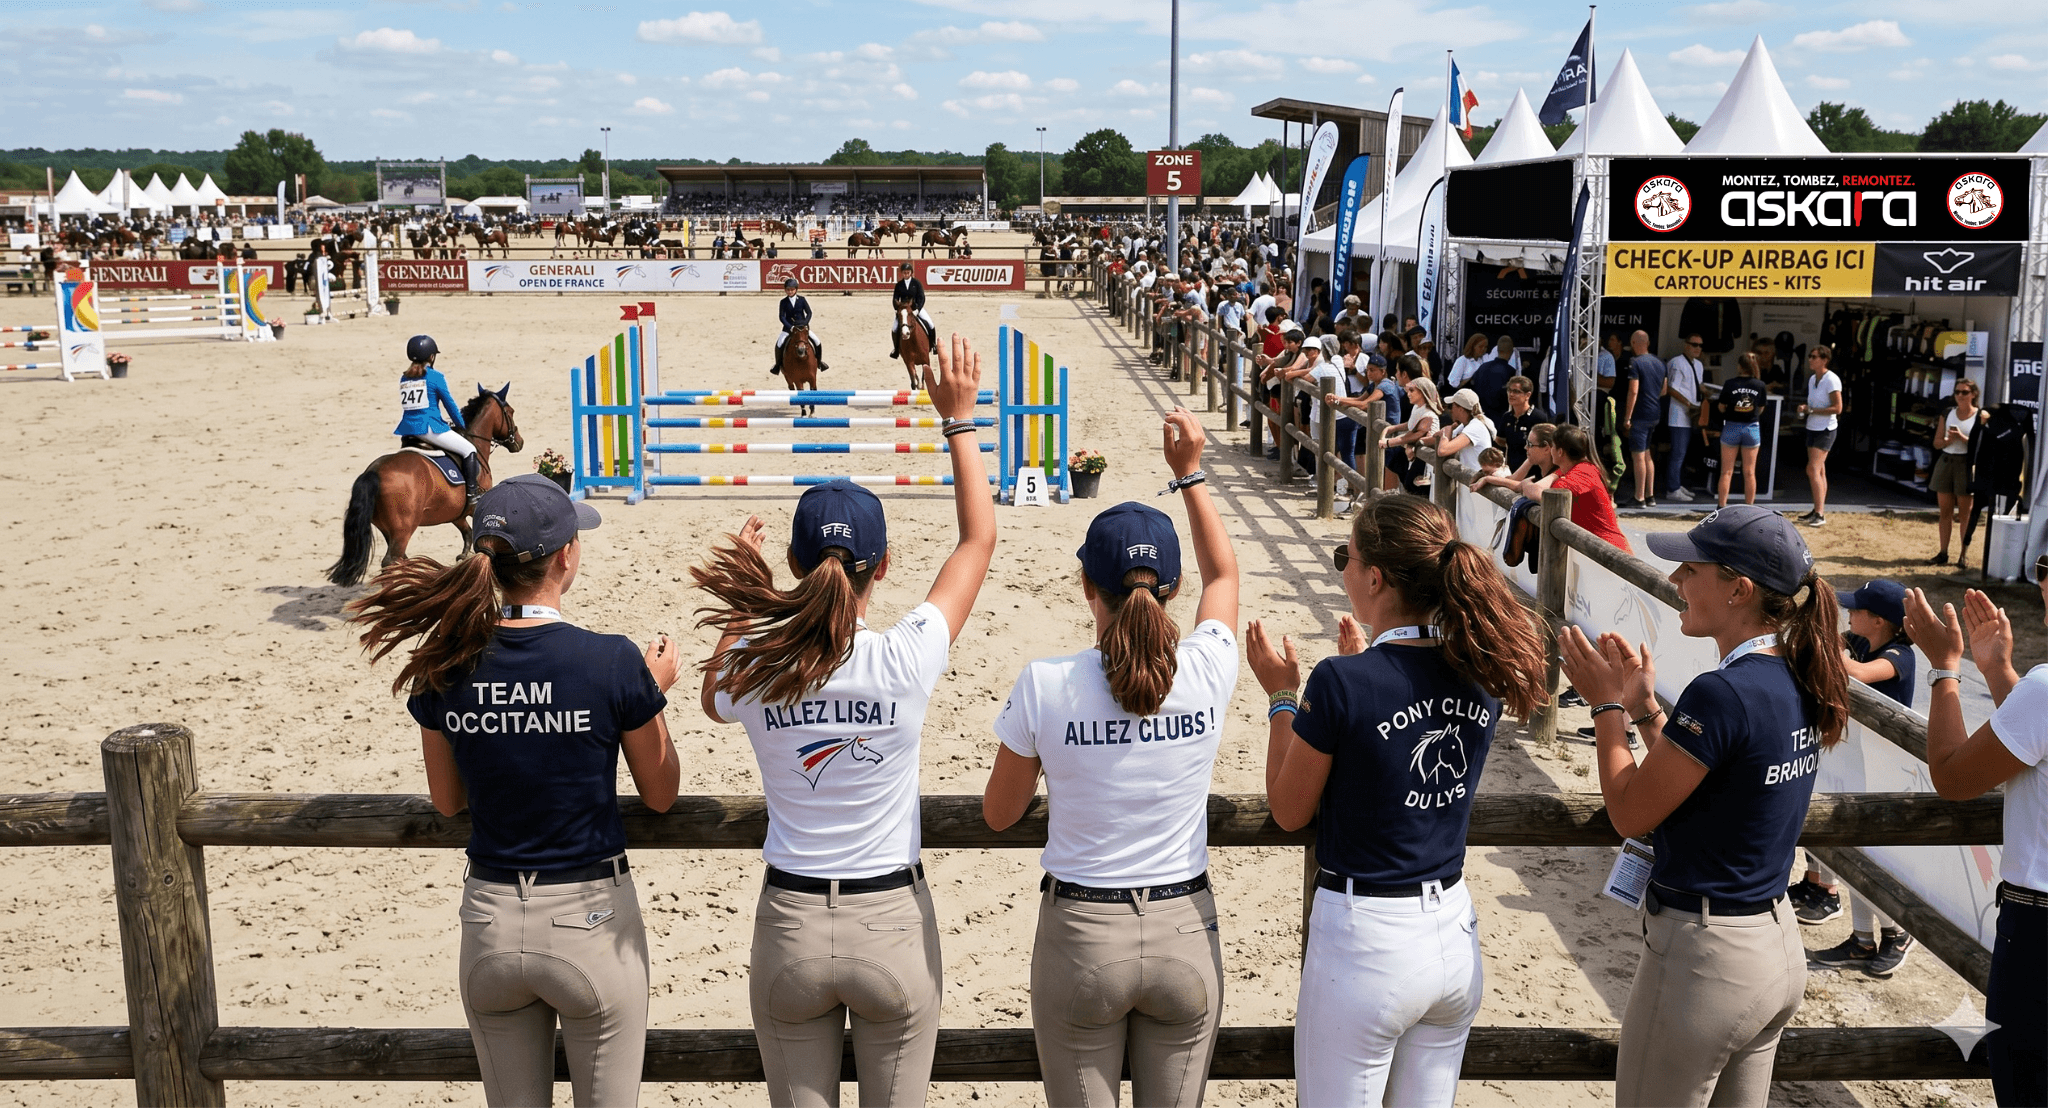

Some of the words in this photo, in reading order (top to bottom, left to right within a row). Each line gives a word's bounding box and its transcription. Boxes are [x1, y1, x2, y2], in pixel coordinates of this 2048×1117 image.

[1155, 154, 1193, 166] ZONE
[1166, 170, 1182, 191] 5
[1722, 175, 1780, 187] MONTEZ,
[1783, 175, 1839, 187] TOMBEZ,
[1842, 175, 1915, 186] REMONTEZ.
[1720, 190, 1917, 227] askara
[1614, 249, 1733, 269] CHECK-UP
[1740, 249, 1828, 269] AIRBAG
[1836, 249, 1865, 269] ICI
[89, 265, 168, 283] GENERALI
[386, 264, 465, 280] GENERALI
[529, 264, 594, 276] GENERALI
[800, 265, 899, 284] GENERALI
[954, 268, 1007, 283] EQUIDIA
[519, 278, 548, 288] OPEN
[549, 278, 563, 288] DE
[565, 278, 605, 288] FRANCE
[1654, 275, 1768, 290] CARTOUCHES
[1785, 275, 1821, 290] KITS
[1905, 276, 1943, 291] hit
[1948, 276, 1987, 291] air
[1486, 287, 1540, 299] SÉCURITÉ
[1542, 289, 1551, 299] &
[1475, 313, 1542, 325] CHECK-UP
[401, 389, 424, 405] 247
[1027, 476, 1036, 493] 5
[822, 523, 852, 539] FFE
[1127, 544, 1157, 560] FFE
[472, 682, 552, 705] TEAM
[445, 709, 592, 734] OCCITANIE
[764, 700, 829, 731] ALLEZ
[834, 700, 883, 725] LISA
[890, 702, 896, 726] !
[1376, 698, 1434, 740] PONY
[1441, 698, 1491, 728] CLUB
[1065, 719, 1132, 746] ALLEZ
[1138, 711, 1206, 743] CLUBS
[1210, 707, 1216, 731] !
[1404, 790, 1432, 810] DU
[1436, 782, 1467, 808] LYS
